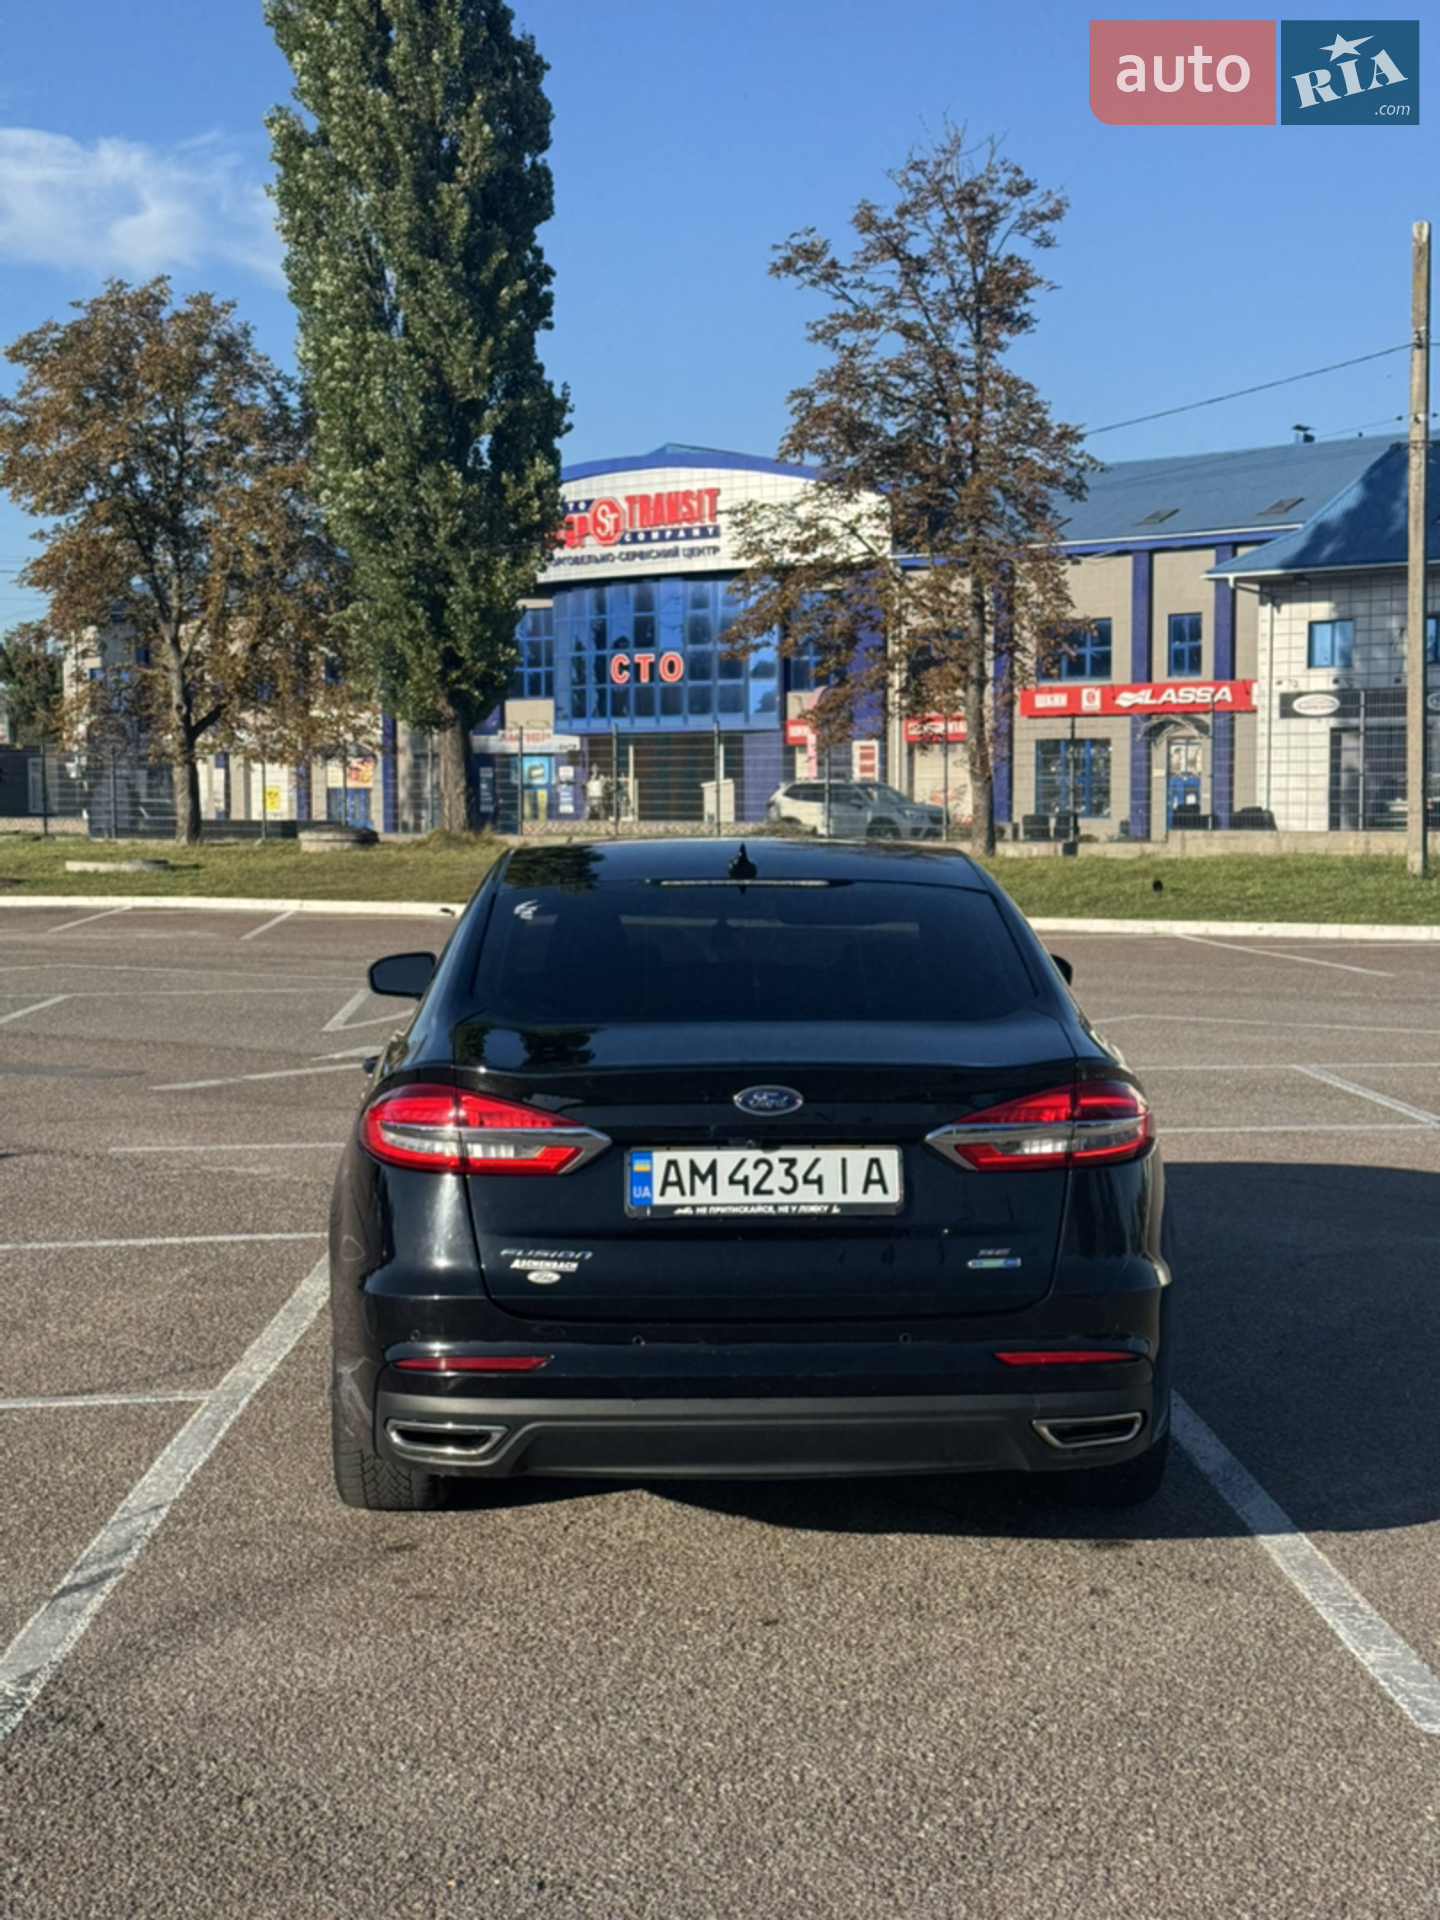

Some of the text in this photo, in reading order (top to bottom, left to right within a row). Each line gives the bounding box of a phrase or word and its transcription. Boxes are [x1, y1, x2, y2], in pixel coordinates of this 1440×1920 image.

[625, 487, 720, 529] TRANSIT
[624, 527, 715, 542] COMPANY
[682, 545, 721, 559] ЦЕНТР
[610, 652, 684, 684] СТО
[1144, 686, 1233, 706] LASSA
[633, 1187, 651, 1199] UA
[696, 1206, 707, 1214] НЕ
[778, 1206, 789, 1214] НЕ
[500, 1248, 593, 1259] FUSION
